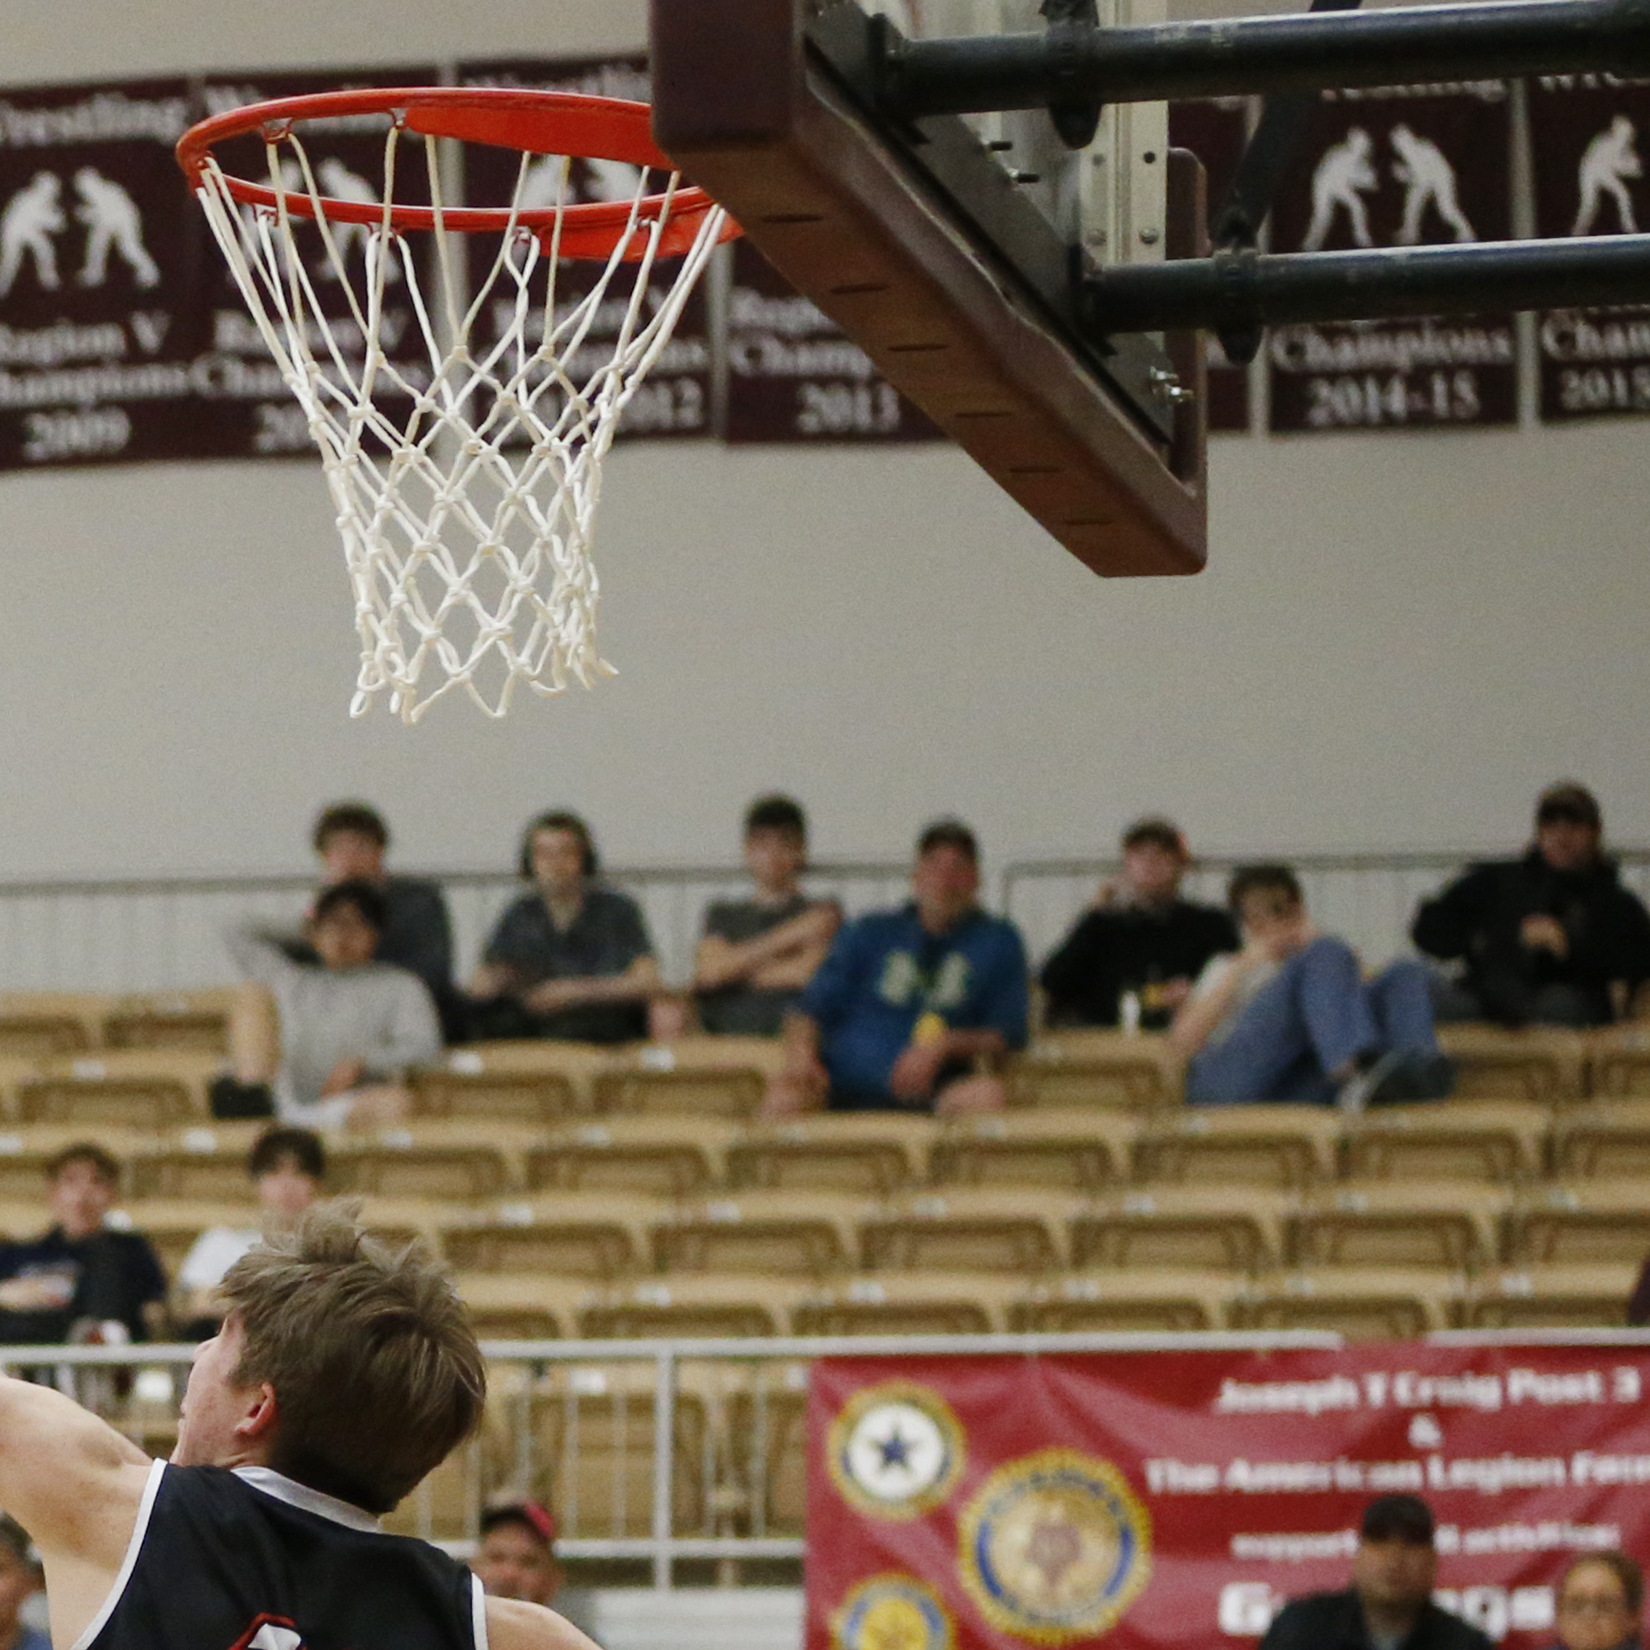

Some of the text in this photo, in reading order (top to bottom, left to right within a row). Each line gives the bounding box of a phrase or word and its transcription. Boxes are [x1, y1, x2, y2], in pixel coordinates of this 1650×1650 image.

[1270, 321, 1513, 374] Champions
[1215, 1375, 1358, 1415] Joseph
[1393, 1369, 1503, 1413] Craig
[1506, 1366, 1603, 1406] Post
[1613, 1365, 1641, 1403] 3
[1407, 1411, 1443, 1449] &
[1145, 1457, 1221, 1495] The
[1223, 1454, 1424, 1494] American
[1427, 1451, 1567, 1495] Legion
